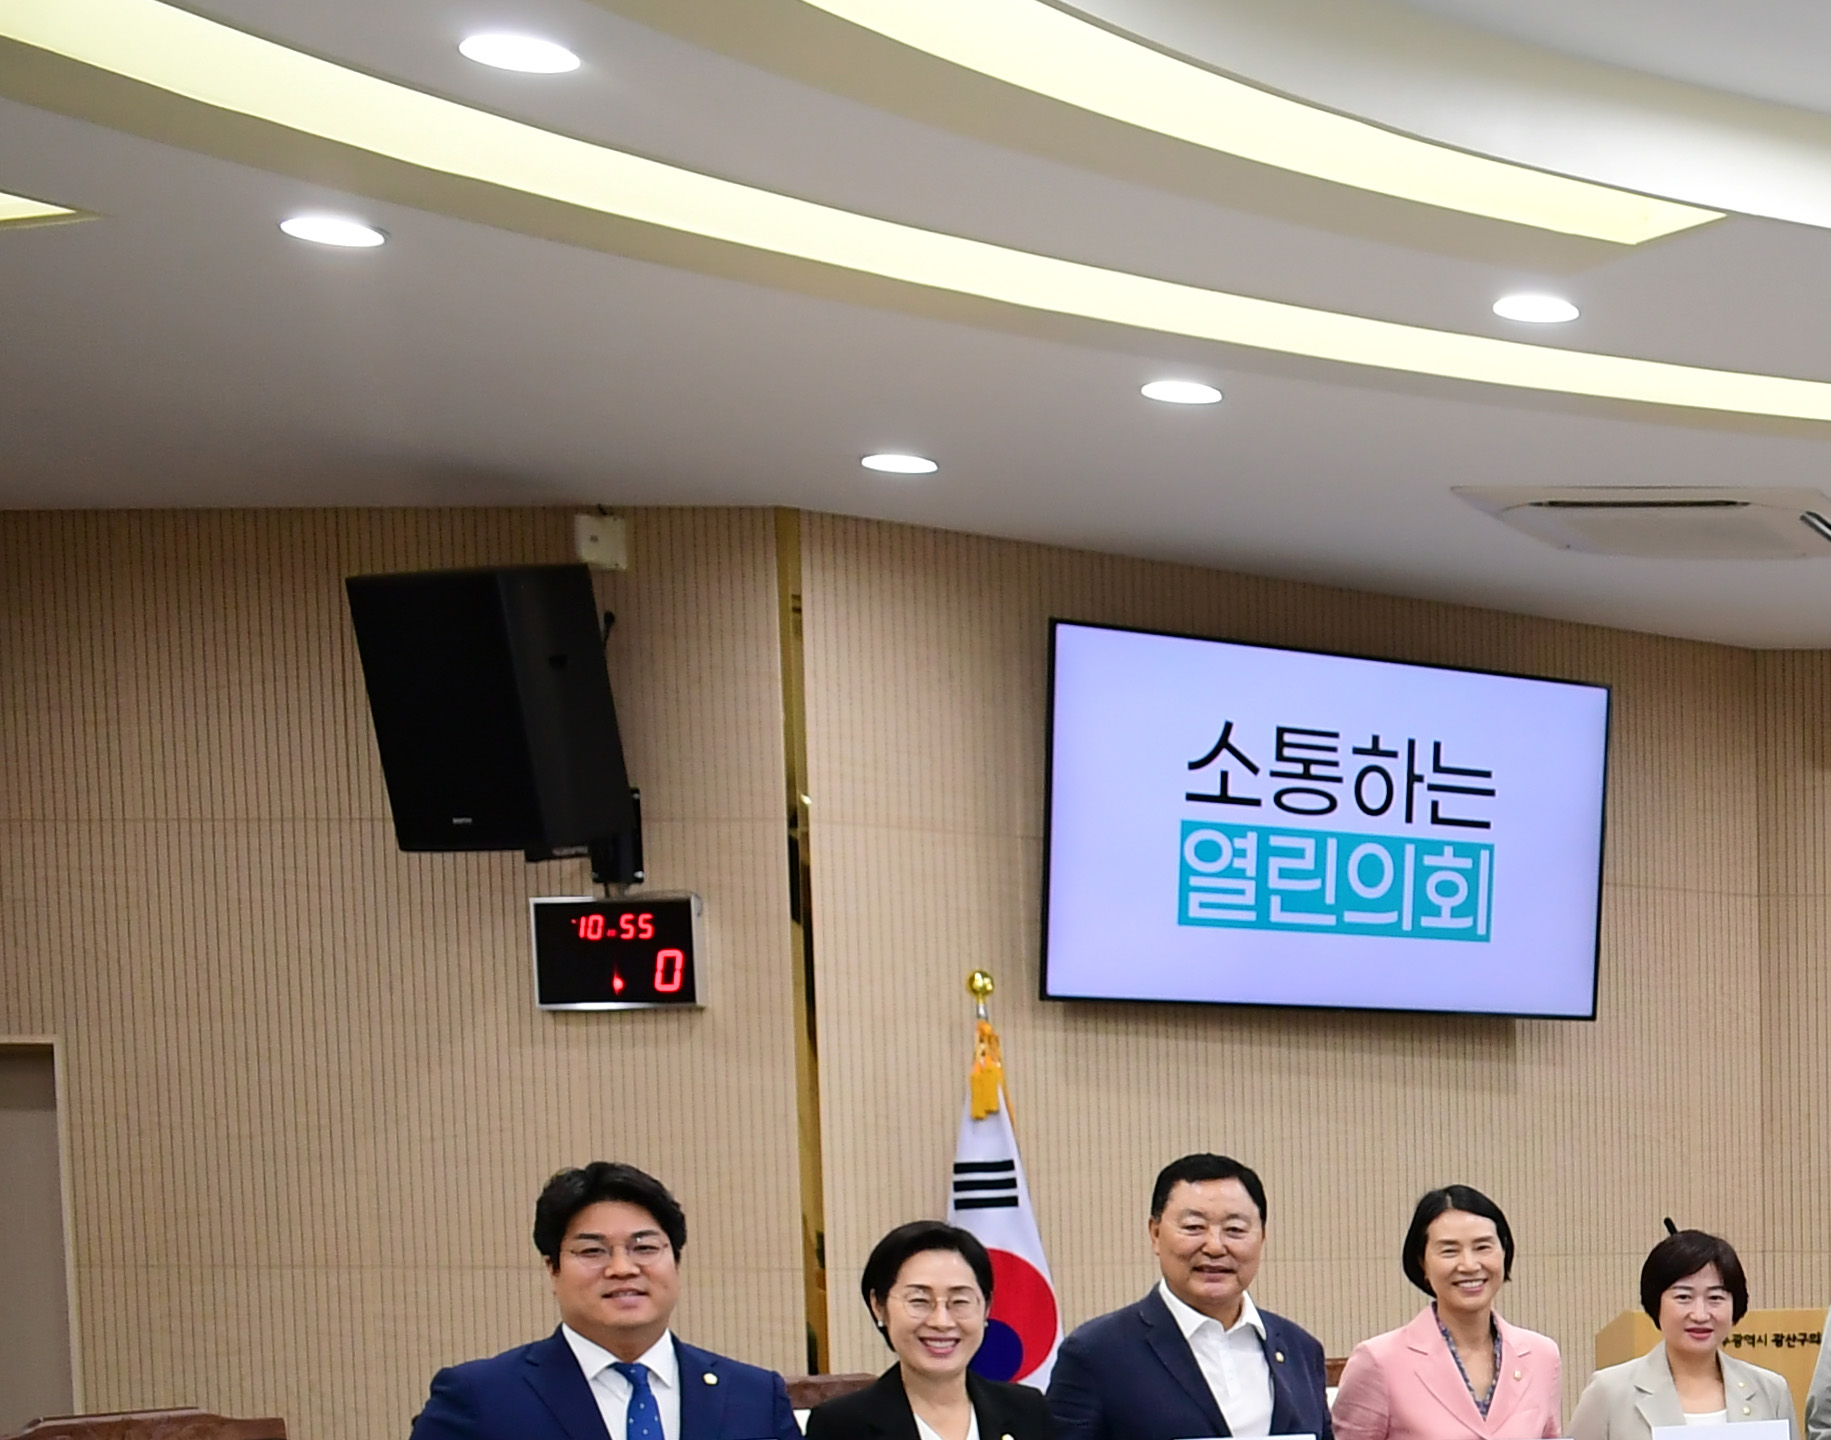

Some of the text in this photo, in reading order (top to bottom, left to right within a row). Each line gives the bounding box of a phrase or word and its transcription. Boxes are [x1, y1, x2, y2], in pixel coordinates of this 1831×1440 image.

[1185, 720, 1497, 830] 소통하는
[1183, 828, 1491, 936] 열린의회
[654, 948, 684, 992] 0
